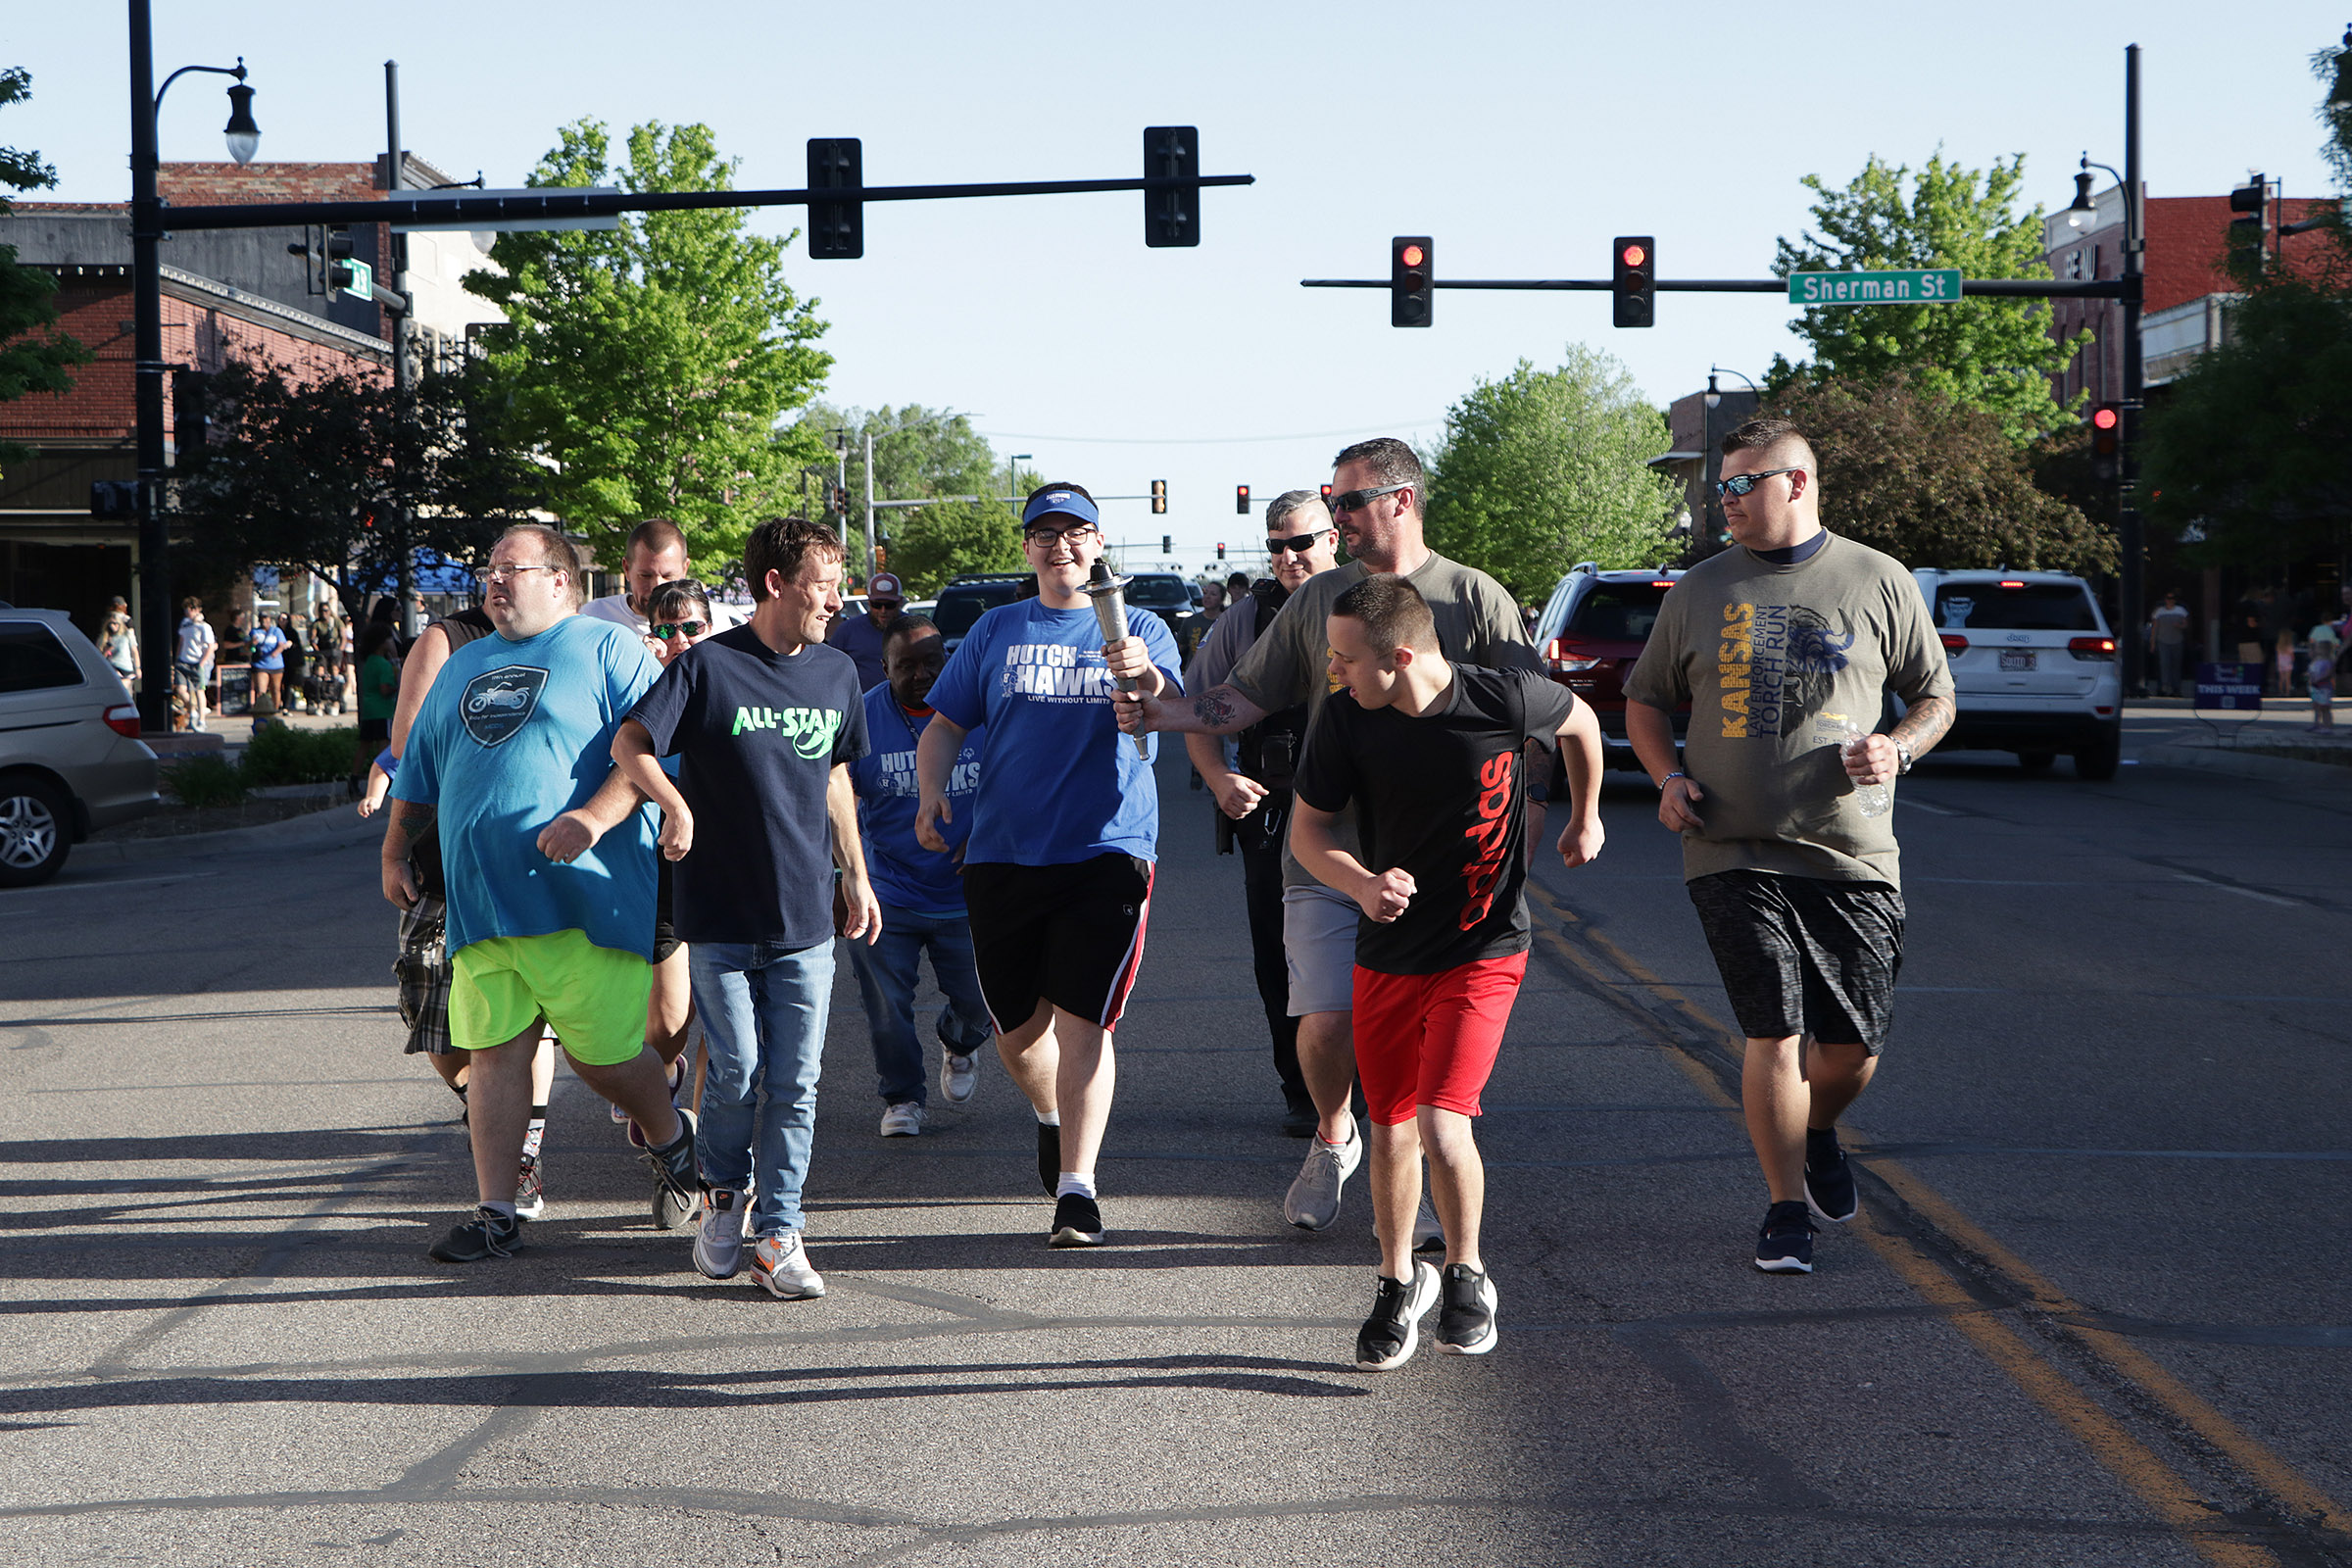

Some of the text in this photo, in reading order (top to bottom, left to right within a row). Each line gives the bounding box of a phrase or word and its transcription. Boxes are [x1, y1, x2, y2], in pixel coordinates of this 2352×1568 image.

[1803, 273, 1946, 301] Sherman St
[1006, 644, 1077, 667] HUTCH
[1718, 603, 1755, 738] KANSAS
[1747, 604, 1768, 738] LAW ENFORCEMENT
[1760, 605, 1788, 739] TORCH RUN
[1014, 664, 1118, 698] HAWKS
[2197, 684, 2261, 695] THIS WEEK
[880, 750, 916, 773] HUT
[1458, 751, 1513, 931] adidas
